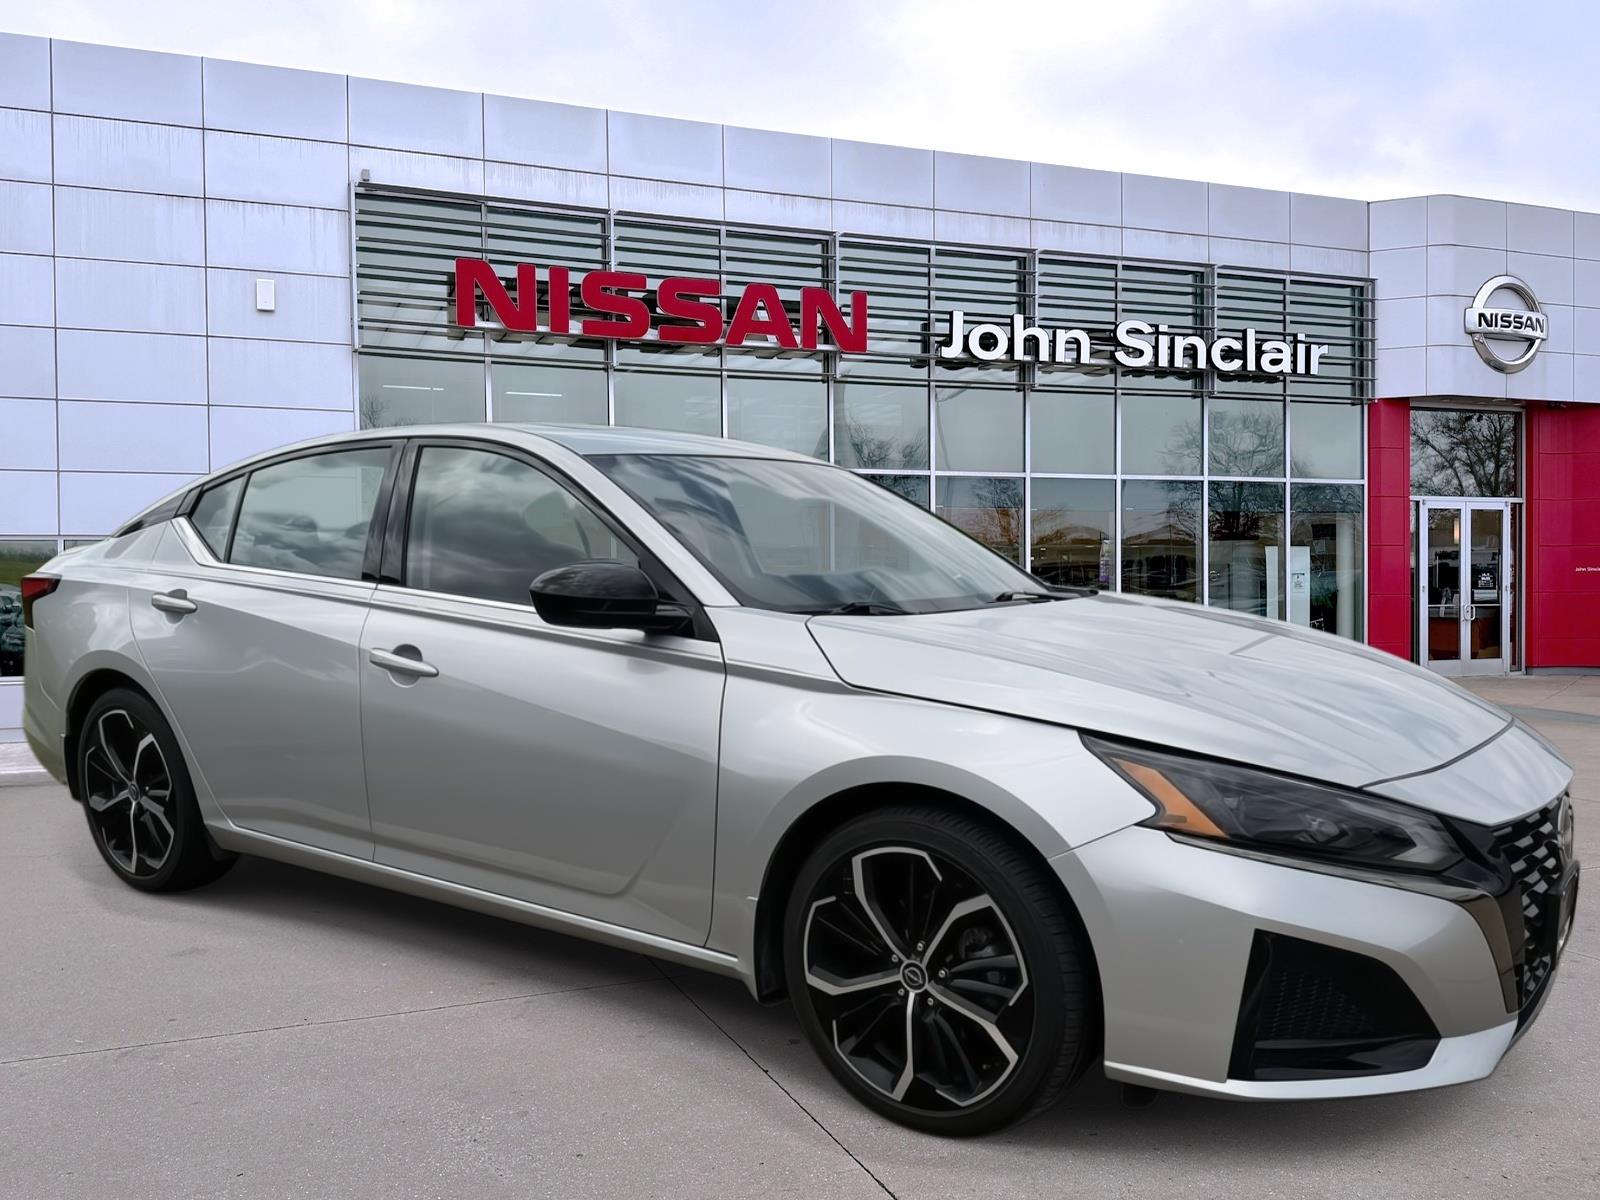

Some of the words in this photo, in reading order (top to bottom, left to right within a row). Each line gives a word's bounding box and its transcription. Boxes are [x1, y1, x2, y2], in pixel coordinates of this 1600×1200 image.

[455, 257, 868, 353] NISSAN
[1478, 312, 1544, 333] NISSAN
[940, 310, 1091, 363] John
[1114, 319, 1329, 375] Sinclair
